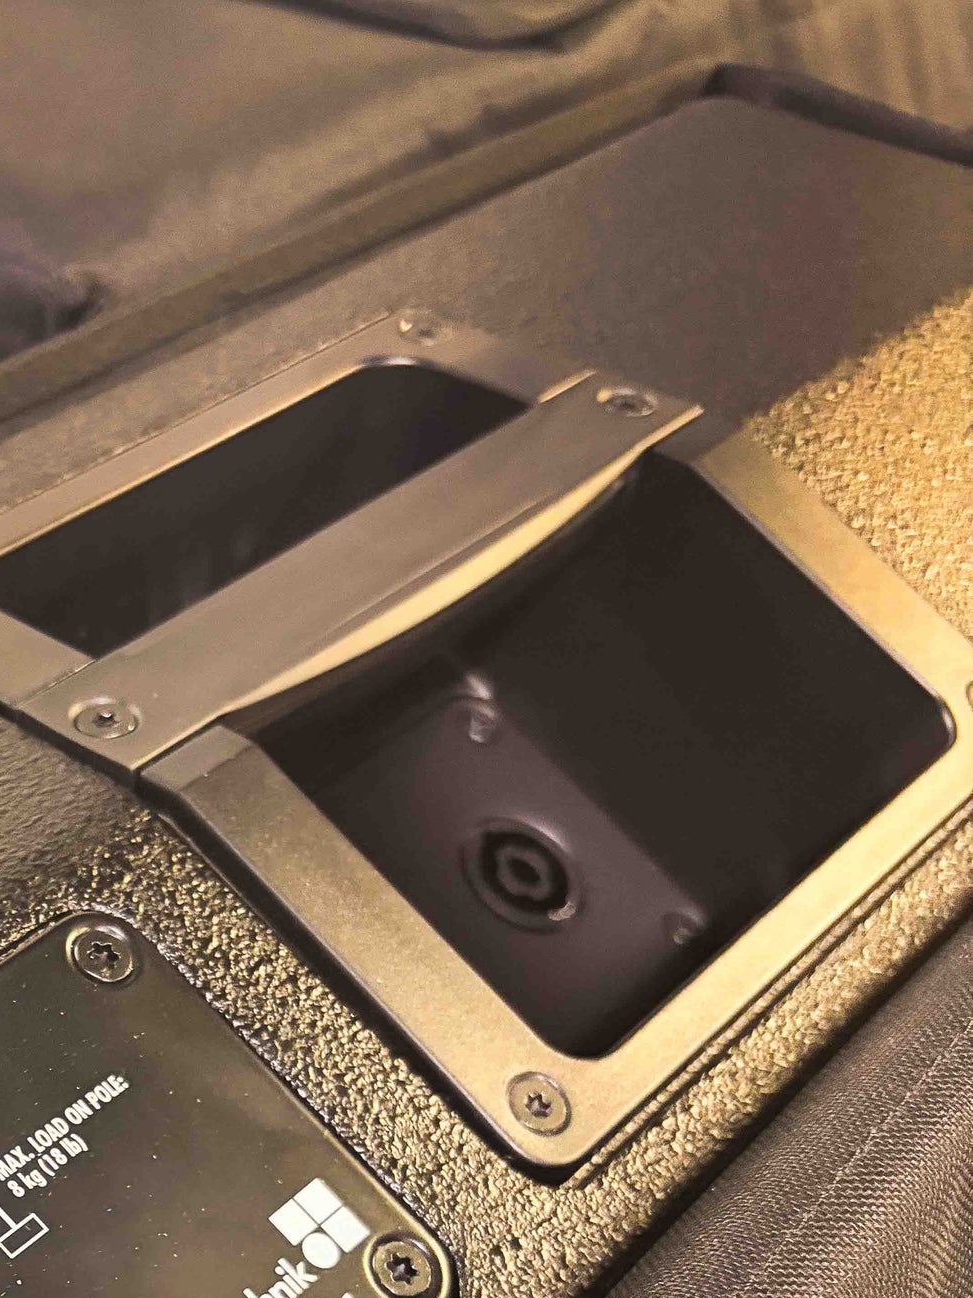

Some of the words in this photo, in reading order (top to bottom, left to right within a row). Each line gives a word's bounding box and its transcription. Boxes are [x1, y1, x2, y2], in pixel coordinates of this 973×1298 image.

[26, 1117, 70, 1153] LOAD
[64, 1099, 94, 1125] ON
[84, 1074, 130, 1110] POLE:
[6, 1180, 26, 1198] 8
[16, 1169, 48, 1190] kg
[37, 1147, 68, 1177] (18
[58, 1133, 89, 1158] lb)
